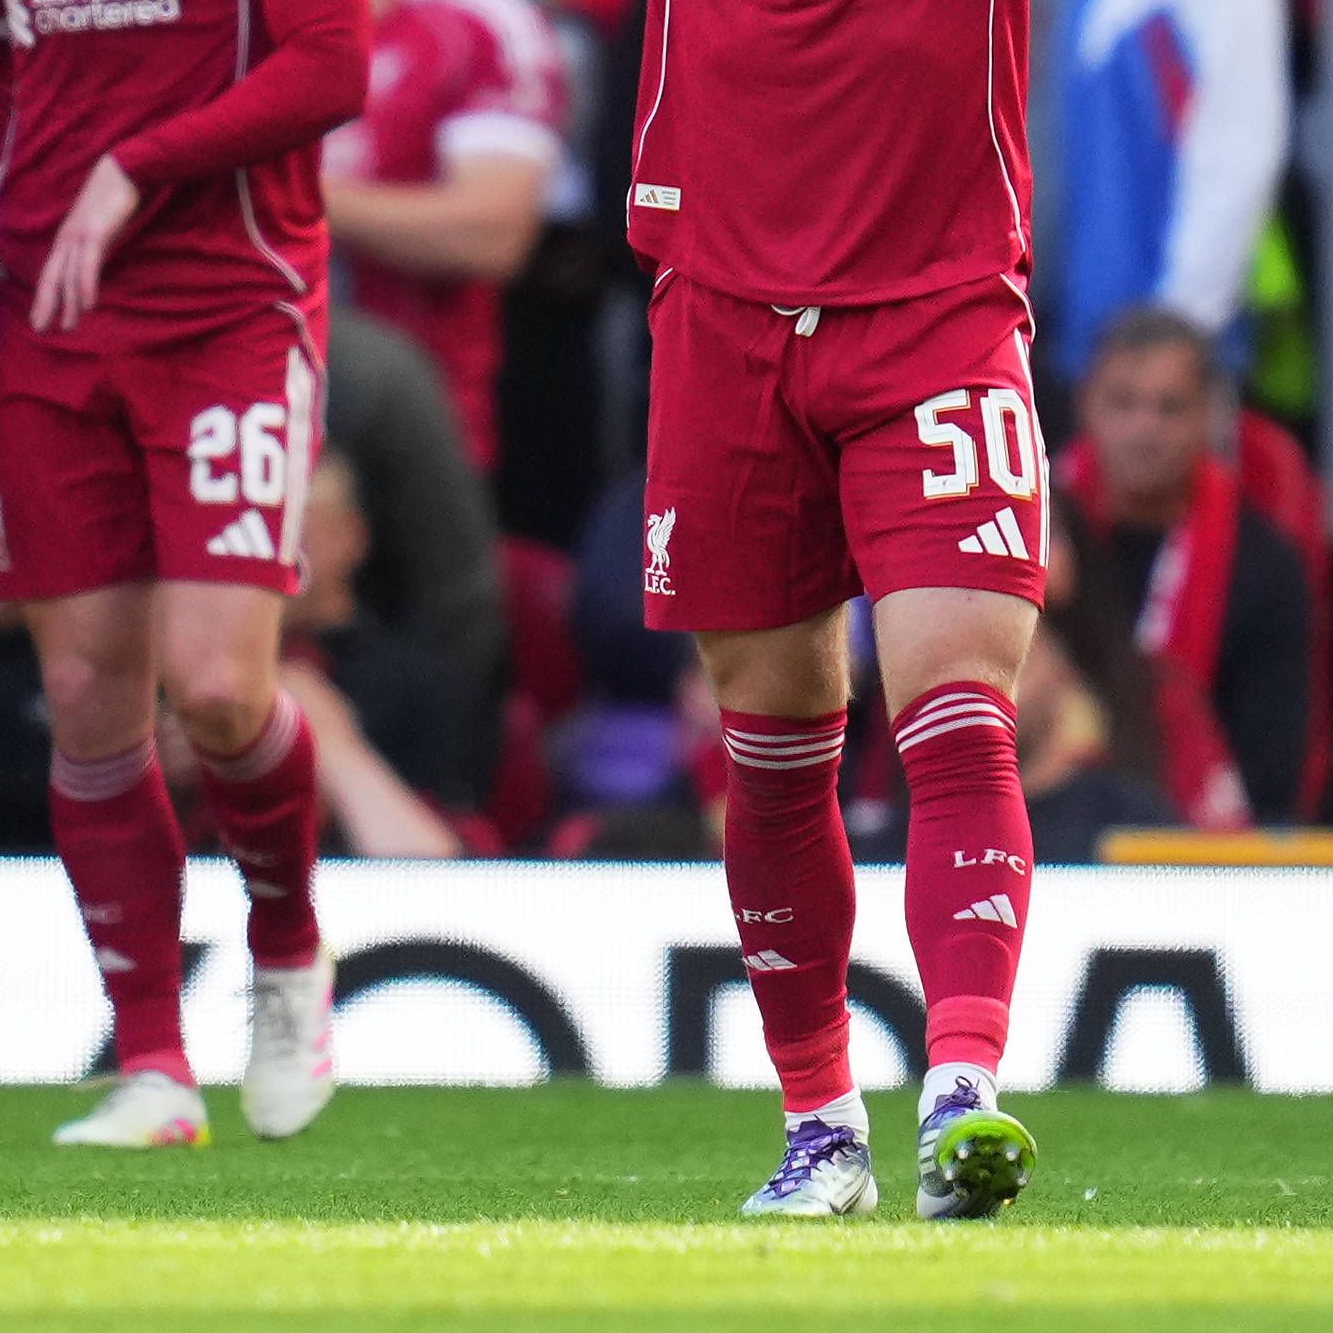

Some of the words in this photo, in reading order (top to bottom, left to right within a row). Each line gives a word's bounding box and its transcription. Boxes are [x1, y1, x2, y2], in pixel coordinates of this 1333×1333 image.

[187, 402, 287, 506] 26
[911, 388, 1037, 501] 50
[953, 848, 1026, 875] LFC
[734, 907, 794, 924] FC
